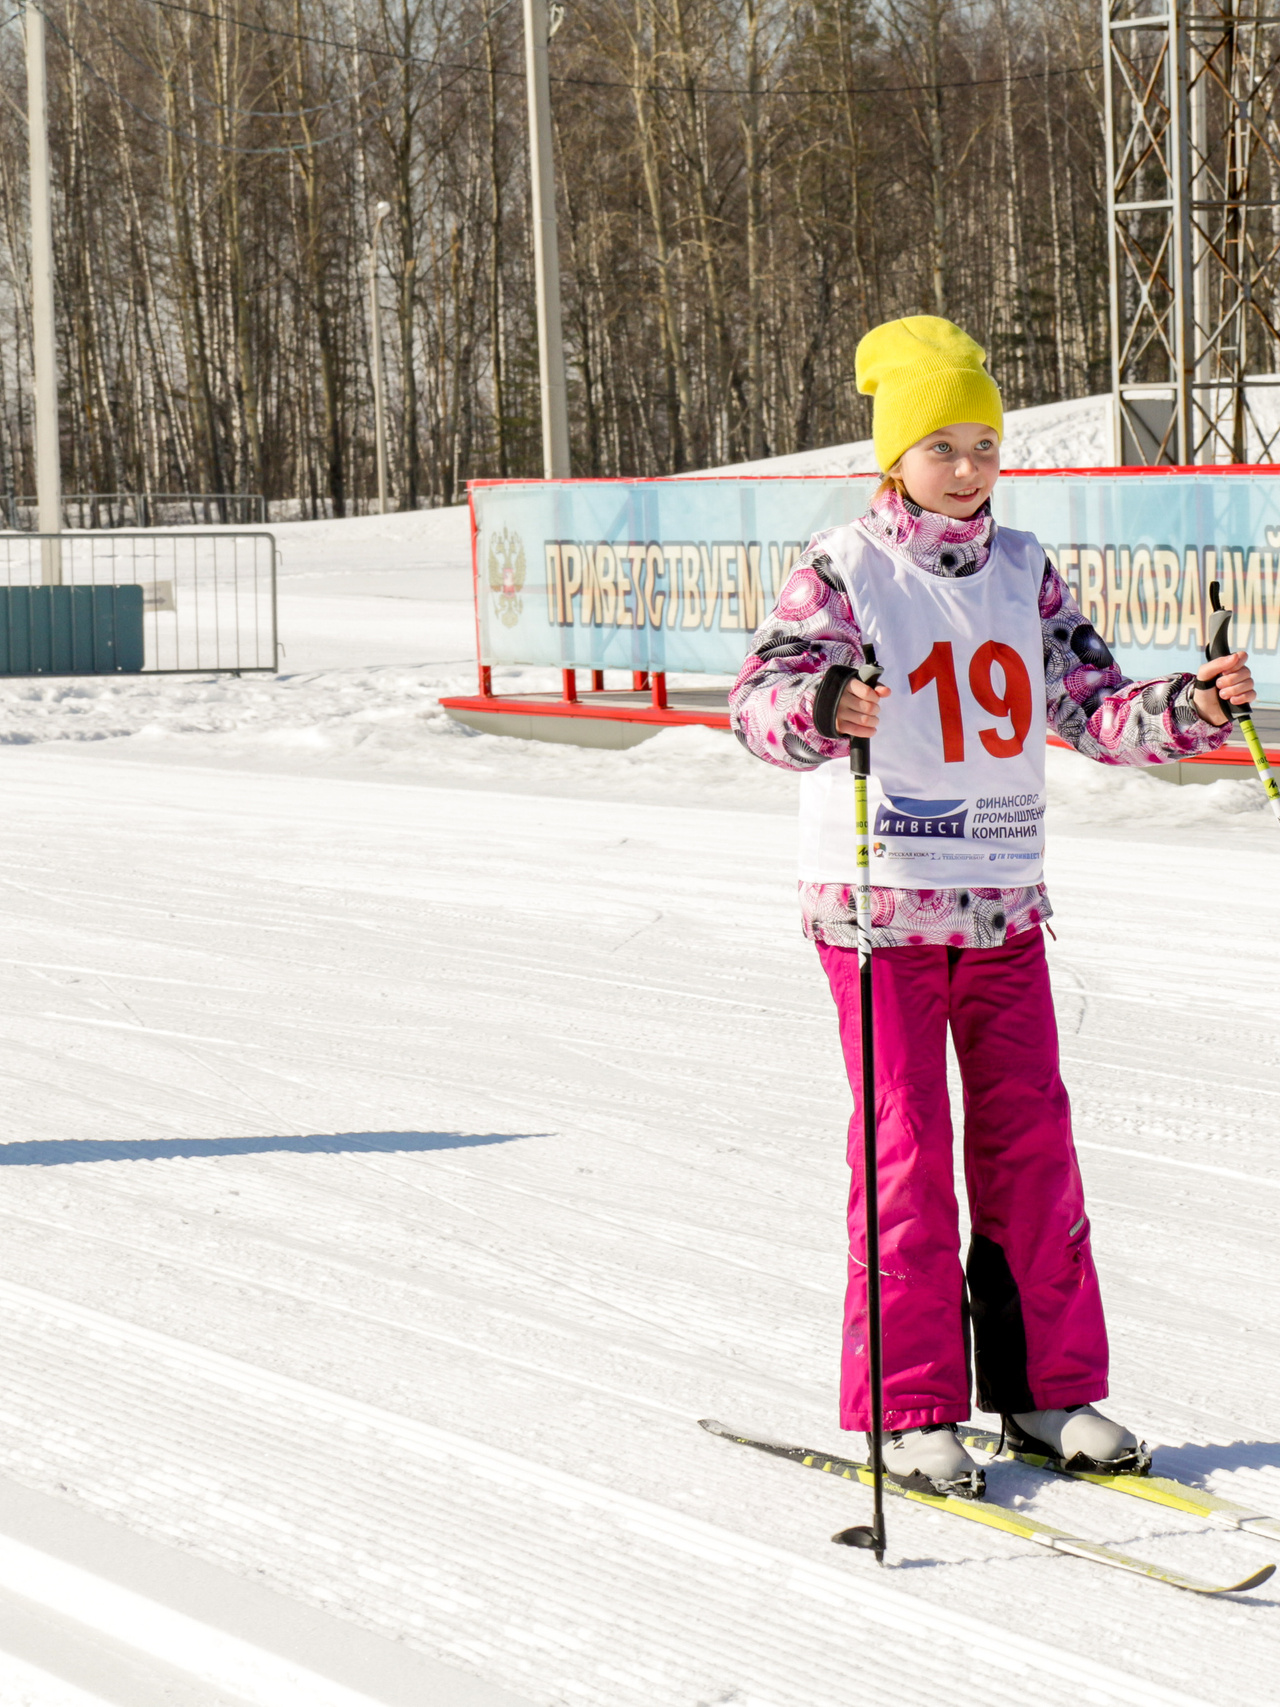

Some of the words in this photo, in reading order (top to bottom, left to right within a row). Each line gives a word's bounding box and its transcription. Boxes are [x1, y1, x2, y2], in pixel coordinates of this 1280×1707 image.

[544, 541, 766, 631] ПРИВЕТСТВУЕМ
[908, 640, 1032, 763] 19
[975, 794, 1040, 810] ФИНАНСОВО-
[879, 820, 960, 835] ИНВЕСТ
[971, 824, 1038, 839] КОМПАНИЯ
